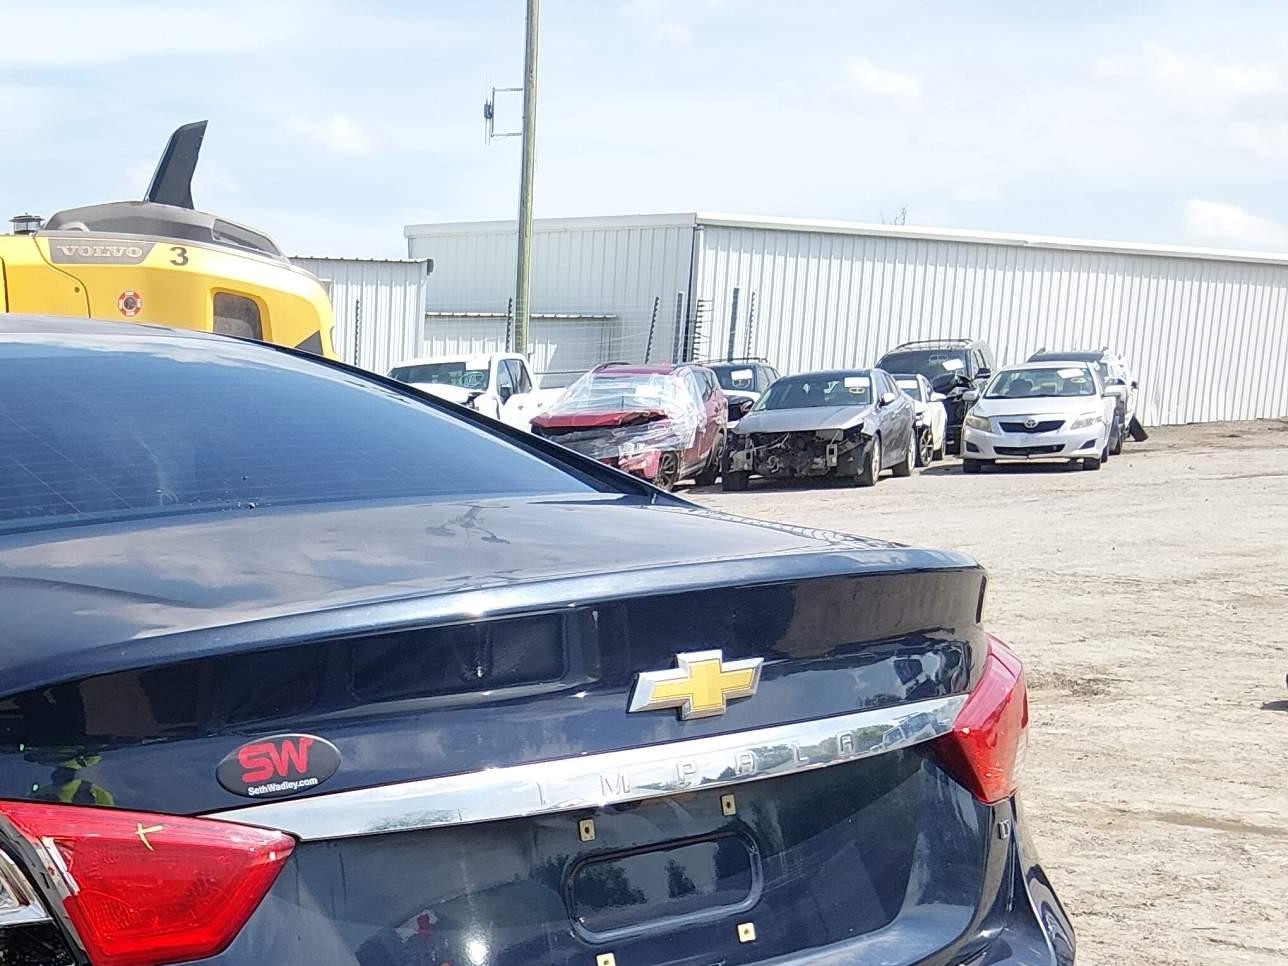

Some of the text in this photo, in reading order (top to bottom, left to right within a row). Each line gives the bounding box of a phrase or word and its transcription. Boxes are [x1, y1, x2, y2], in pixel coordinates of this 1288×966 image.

[56, 244, 143, 258] VOLVO
[169, 246, 189, 266] 3
[238, 736, 314, 783] SW
[536, 732, 856, 806] IMPALA
[248, 778, 318, 796] SethWadley.com
